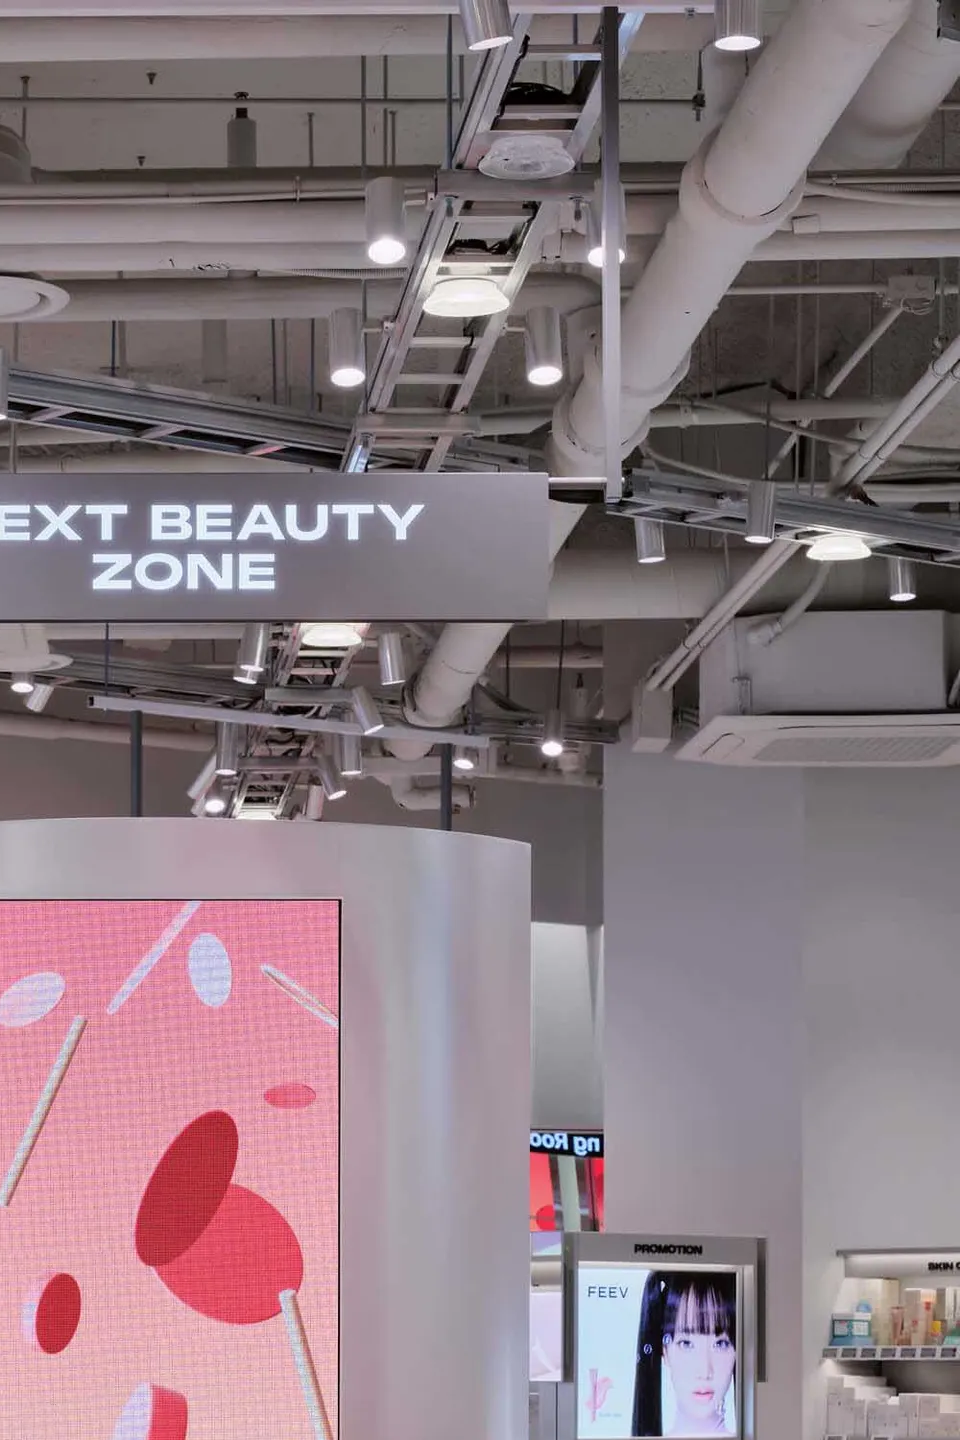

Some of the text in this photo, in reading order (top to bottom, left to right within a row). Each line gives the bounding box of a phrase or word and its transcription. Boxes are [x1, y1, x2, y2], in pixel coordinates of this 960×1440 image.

[151, 504, 425, 541] BEAUTY
[92, 553, 276, 591] ZONE
[634, 1243, 704, 1255] PROMOTION
[927, 1262, 954, 1271] SKIN
[587, 1285, 629, 1298] FEEV
